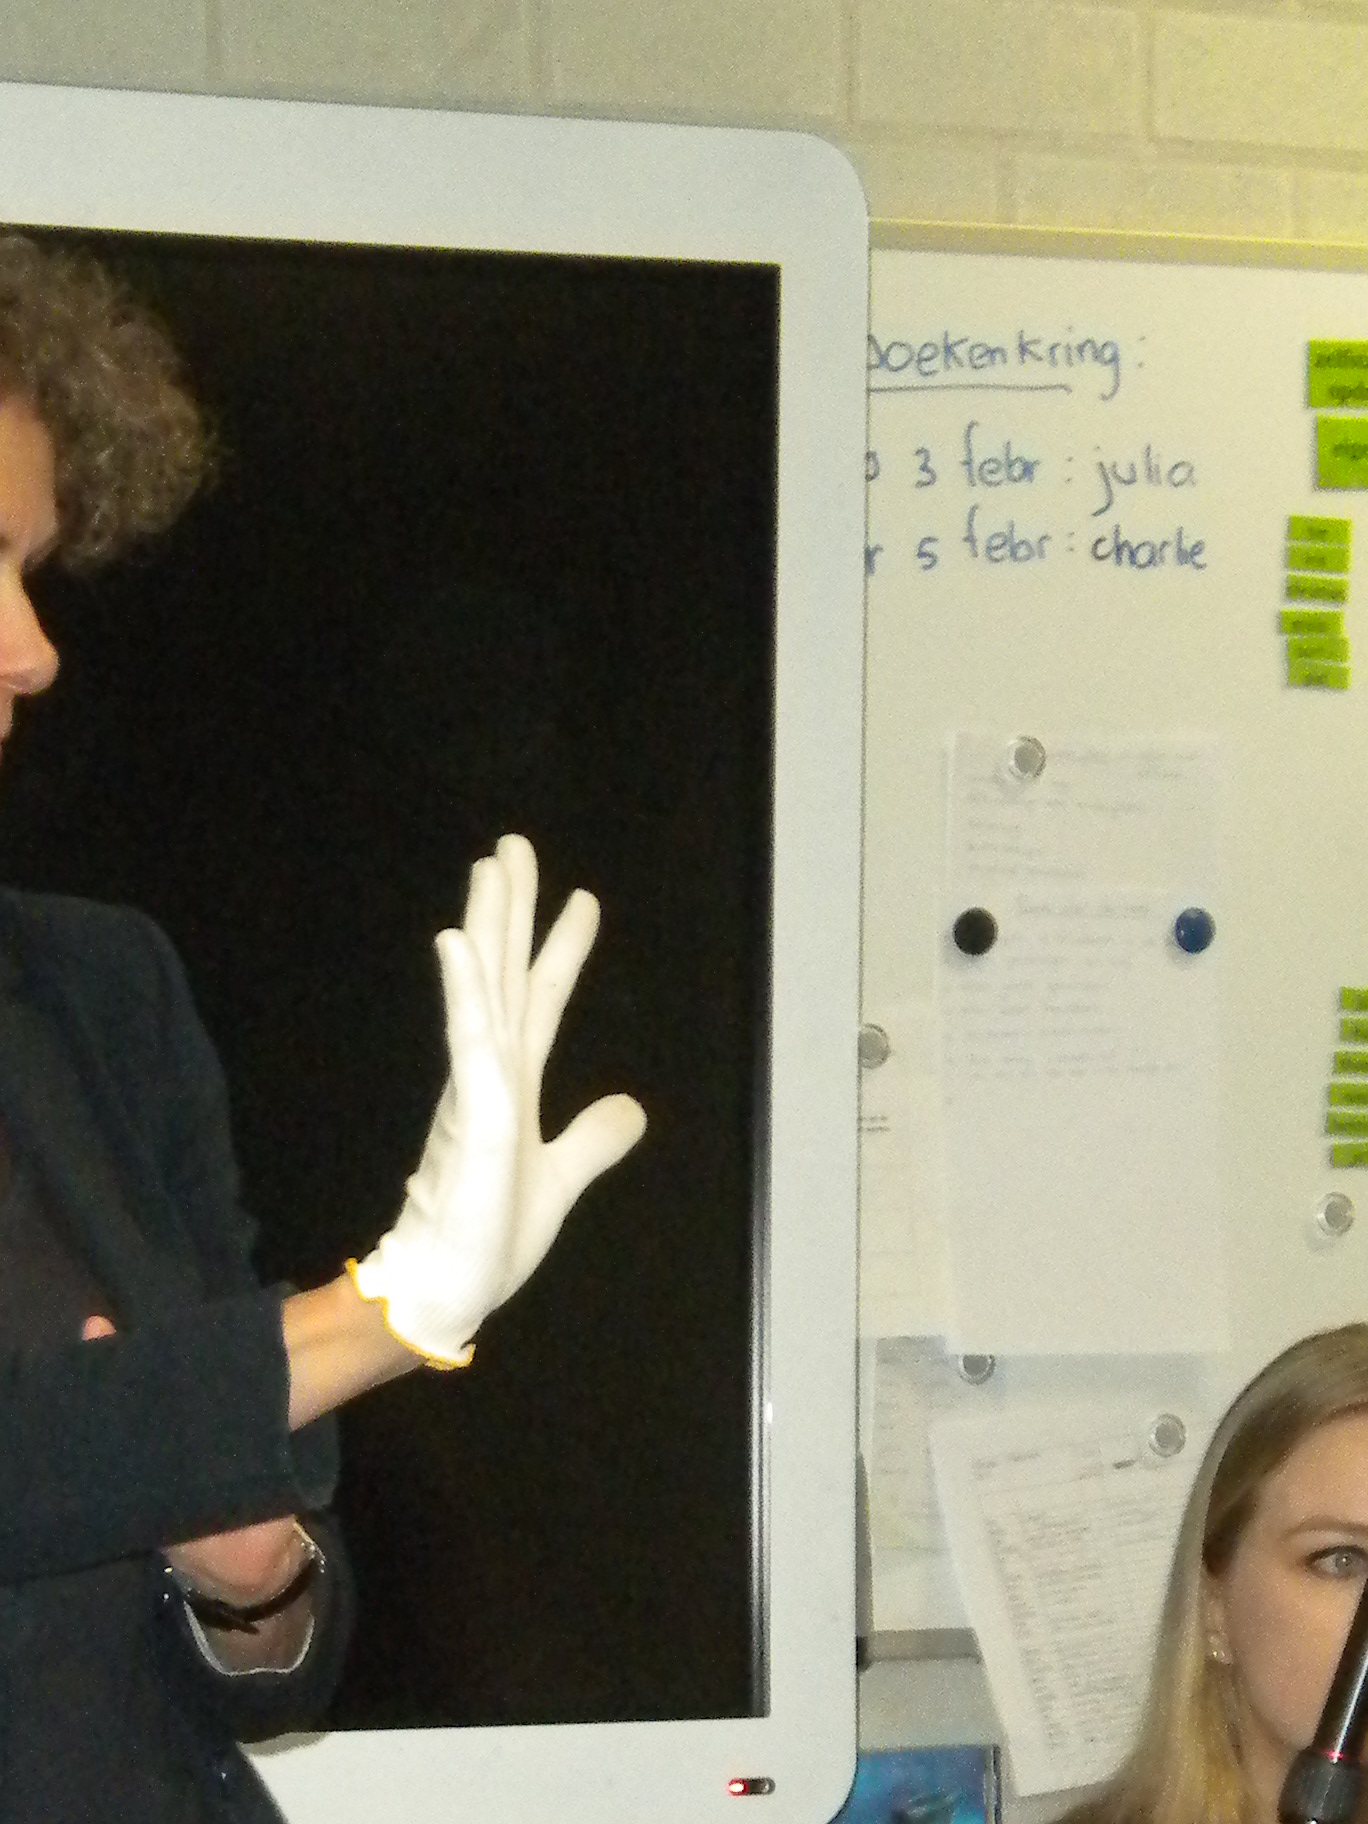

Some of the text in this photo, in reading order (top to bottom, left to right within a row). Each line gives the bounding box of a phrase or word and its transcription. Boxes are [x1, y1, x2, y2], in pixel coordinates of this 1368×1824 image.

[914, 447, 937, 488] 3
[1091, 443, 1196, 517] julia
[916, 536, 939, 571] 5
